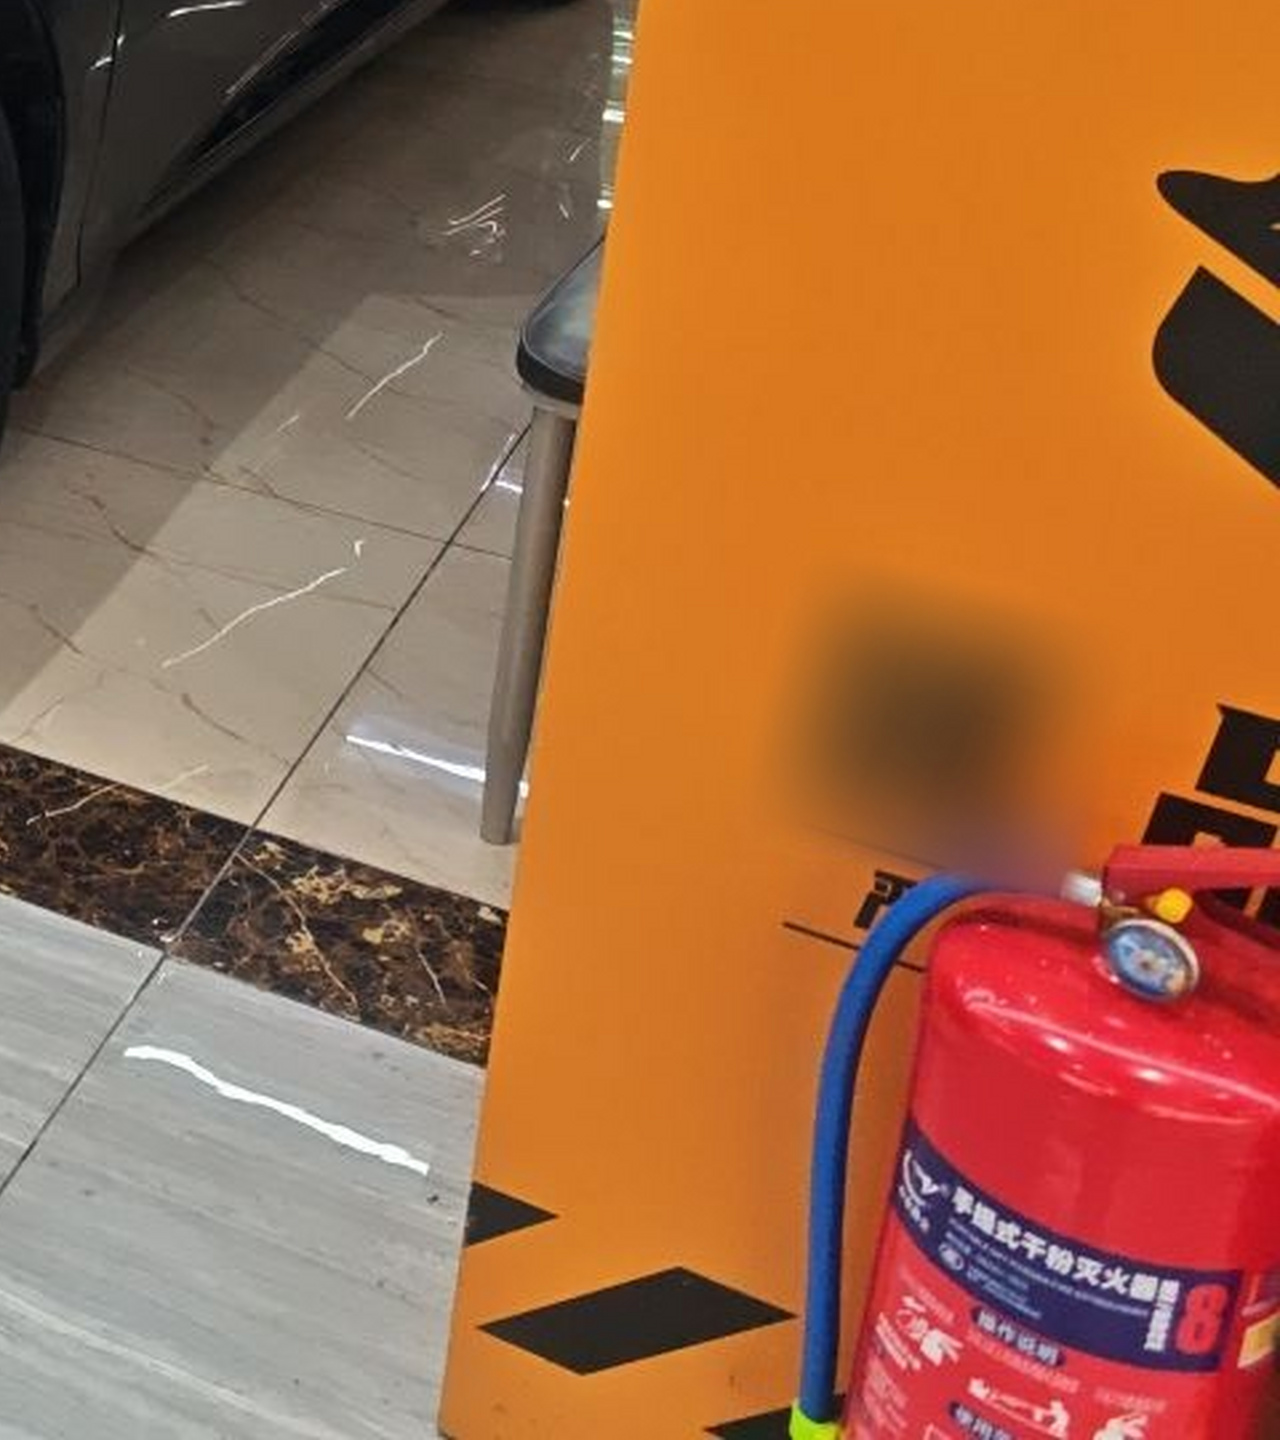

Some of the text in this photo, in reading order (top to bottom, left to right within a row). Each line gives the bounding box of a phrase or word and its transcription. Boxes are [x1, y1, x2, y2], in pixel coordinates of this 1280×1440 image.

[951, 1185, 1159, 1303] 手提式干粉灭火器
[1175, 1283, 1229, 1355] 8
